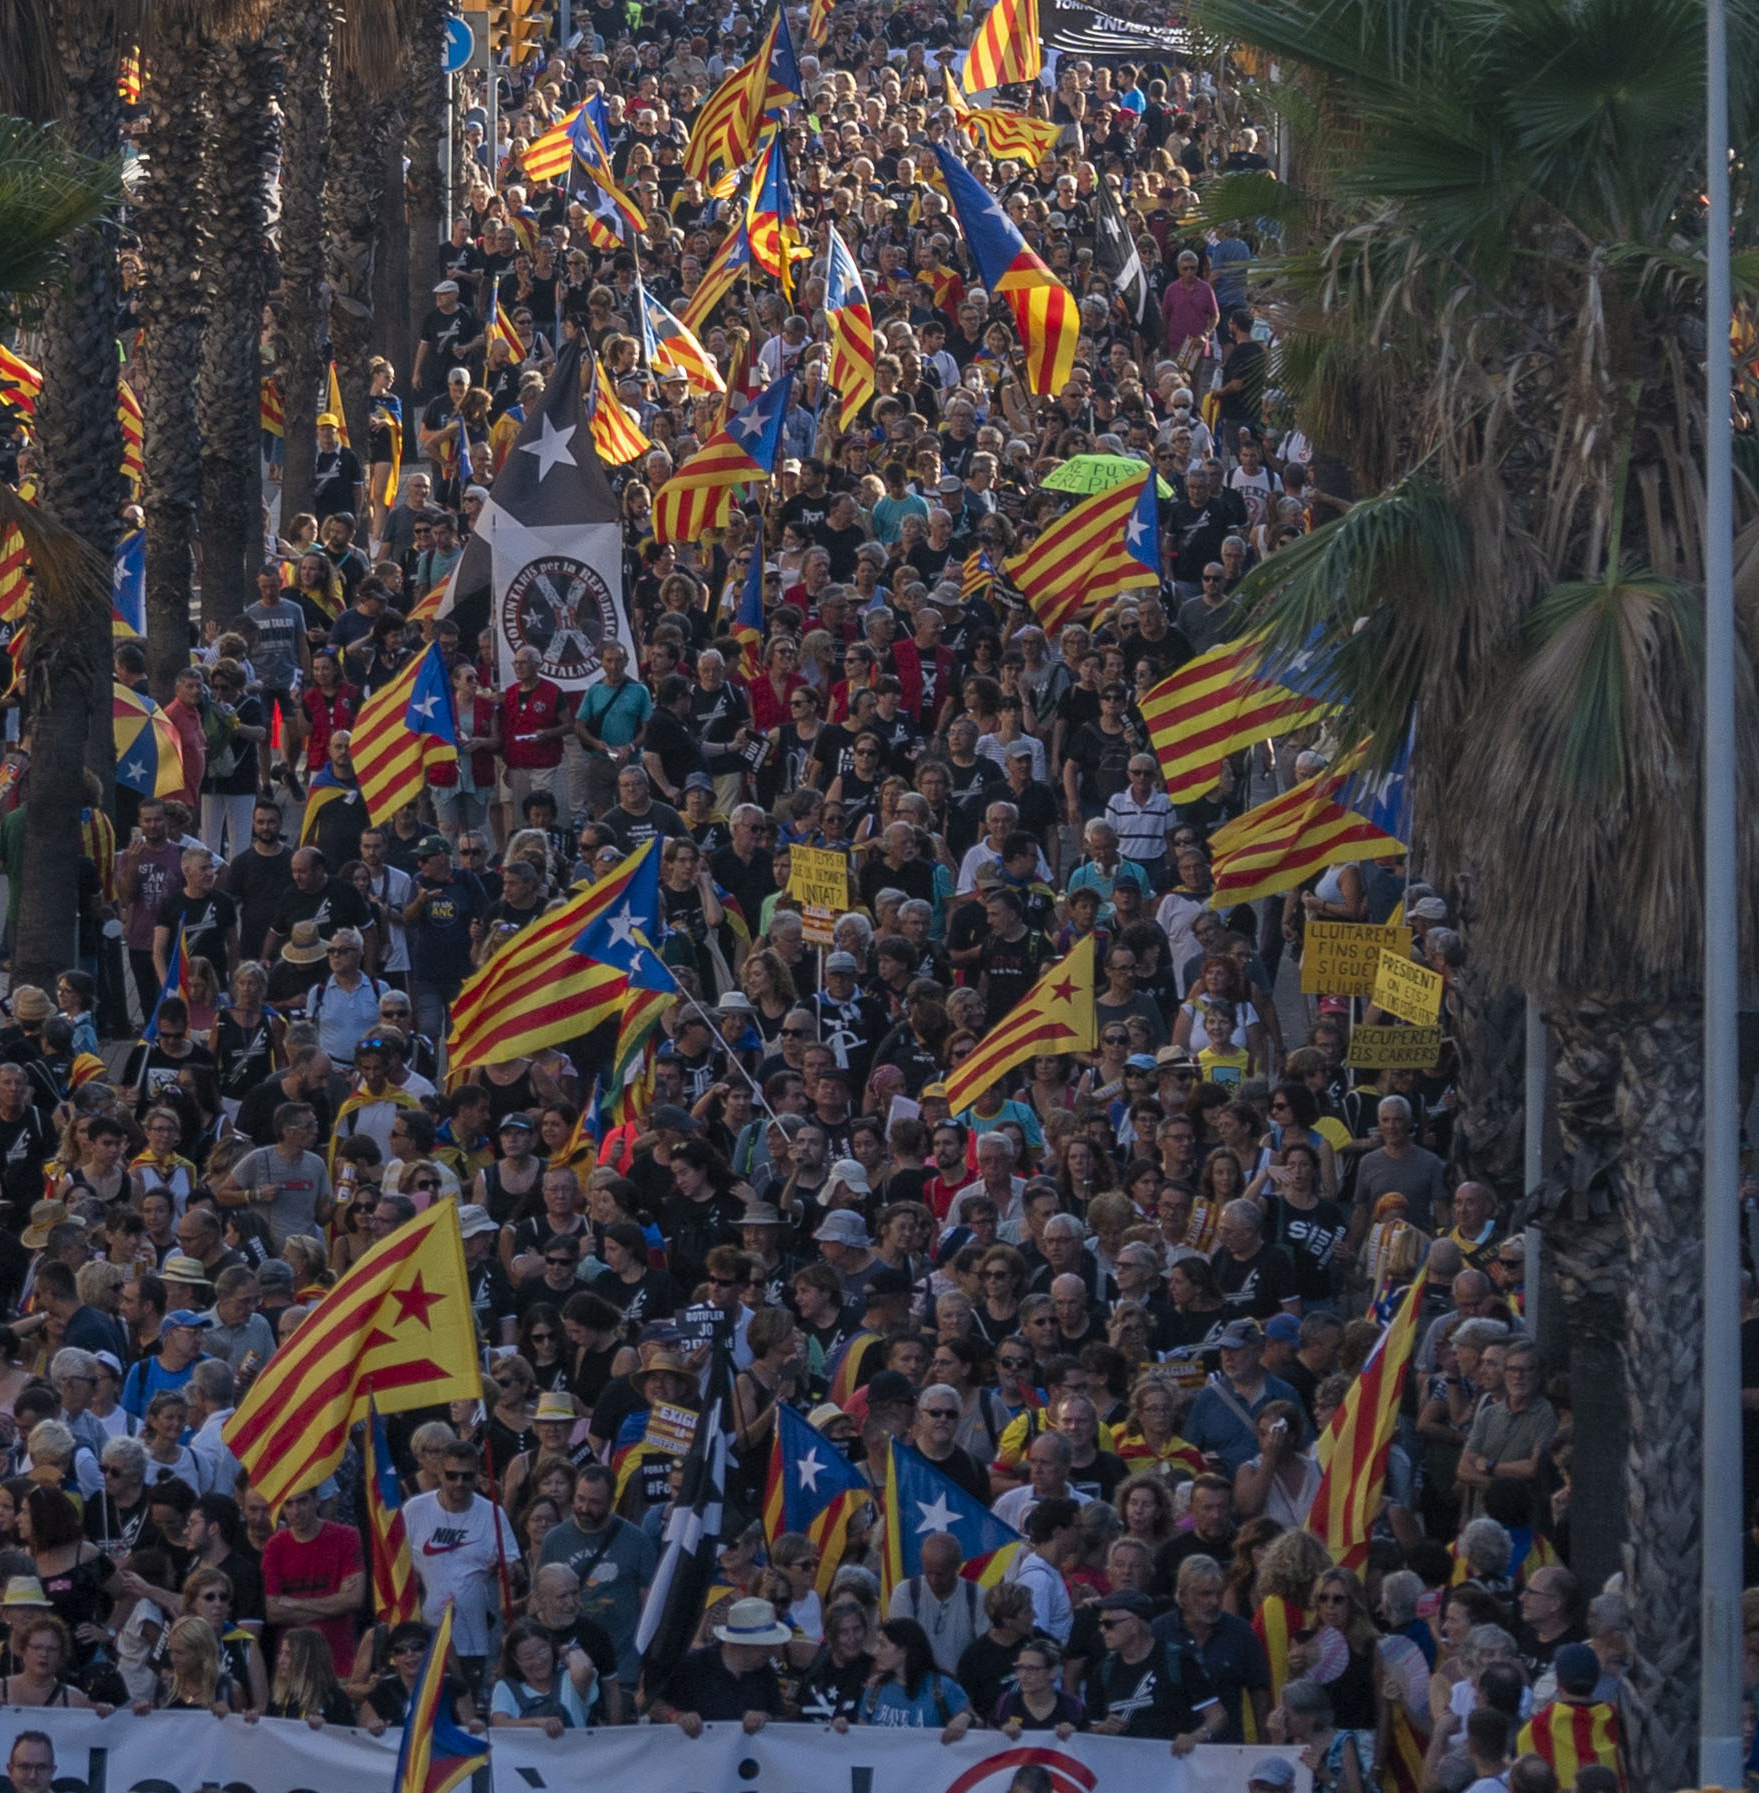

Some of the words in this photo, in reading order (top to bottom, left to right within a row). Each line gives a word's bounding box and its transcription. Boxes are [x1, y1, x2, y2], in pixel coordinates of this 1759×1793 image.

[504, 565, 539, 649] VOLUNTARIS
[540, 655, 602, 678] ATALANA
[1310, 925, 1398, 944] LLUITAREM
[1318, 941, 1359, 960] FINS
[1318, 961, 1378, 978] SIGUE
[1382, 952, 1439, 992] PRESIDENT
[1315, 980, 1375, 995] LLIURE
[1352, 1027, 1442, 1047] RECUPEREM
[1349, 1047, 1374, 1063] ELS
[1377, 1046, 1439, 1064] CARRERS
[659, 1406, 698, 1428] EXIGI
[431, 1527, 470, 1545] NIKE
